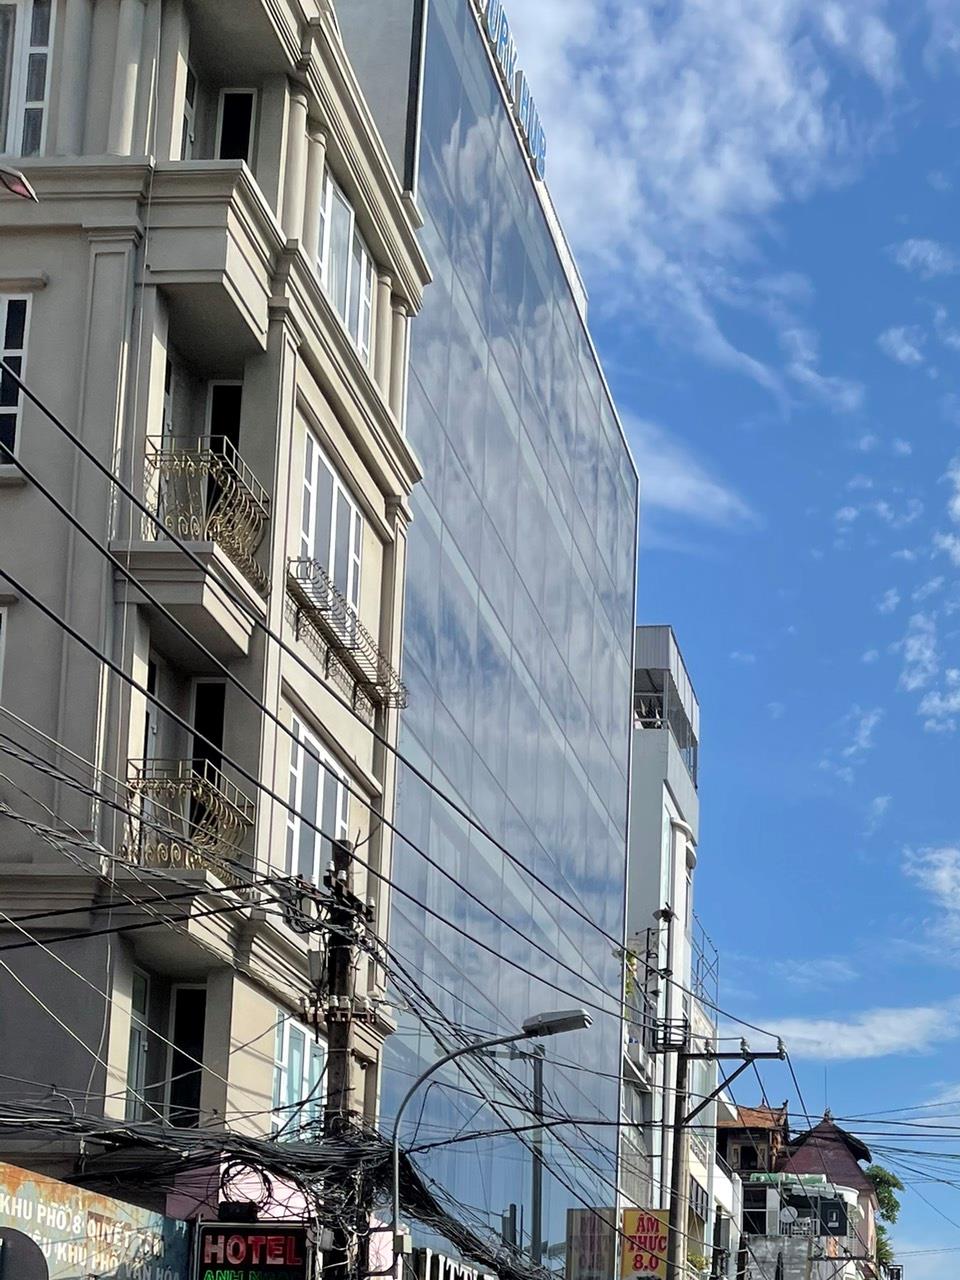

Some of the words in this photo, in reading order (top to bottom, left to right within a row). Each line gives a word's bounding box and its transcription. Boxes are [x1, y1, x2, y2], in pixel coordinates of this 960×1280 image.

[0, 1193, 33, 1221] KHU
[73, 1215, 82, 1234] 8
[56, 1243, 87, 1266] KHU
[203, 1234, 303, 1265] HOTEL
[633, 1254, 660, 1272] 8.0
